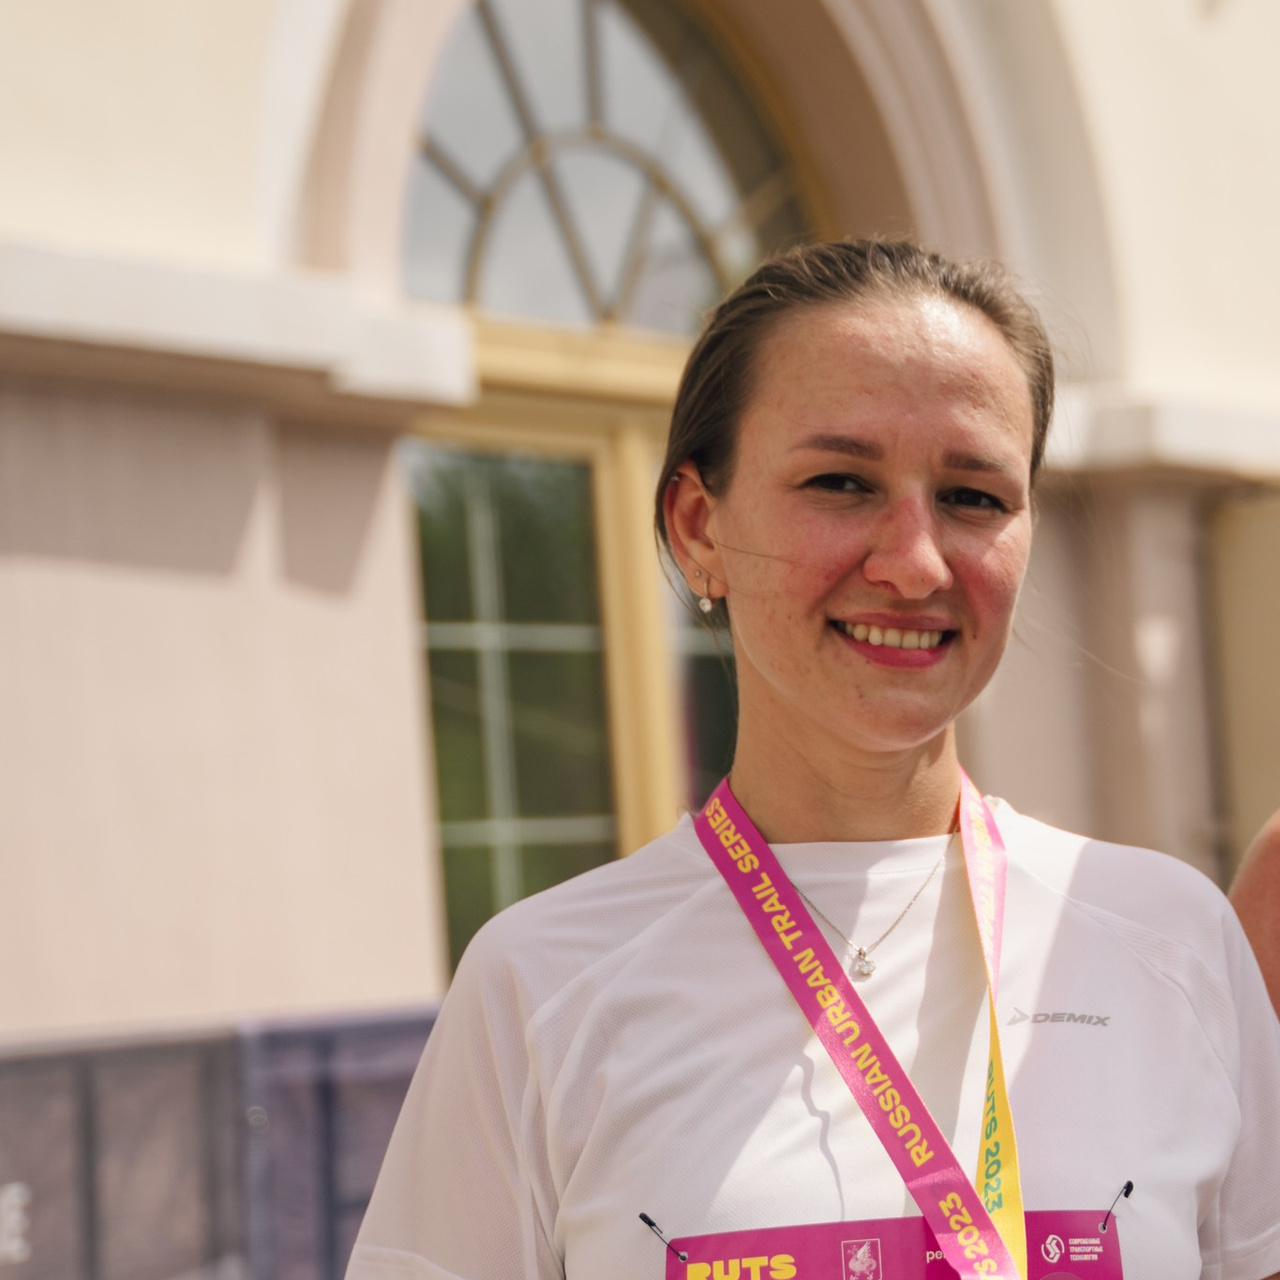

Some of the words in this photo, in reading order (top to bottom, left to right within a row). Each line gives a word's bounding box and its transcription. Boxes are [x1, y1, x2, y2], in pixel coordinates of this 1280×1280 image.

[705, 797, 760, 874] SERIES
[752, 872, 803, 951] TRAIL
[793, 947, 862, 1046] URBAN
[1031, 1013, 1111, 1027] DEMIX
[849, 1043, 935, 1168] RUSSIAN
[984, 1141, 1004, 1215] 2023
[938, 1191, 990, 1261] 2023
